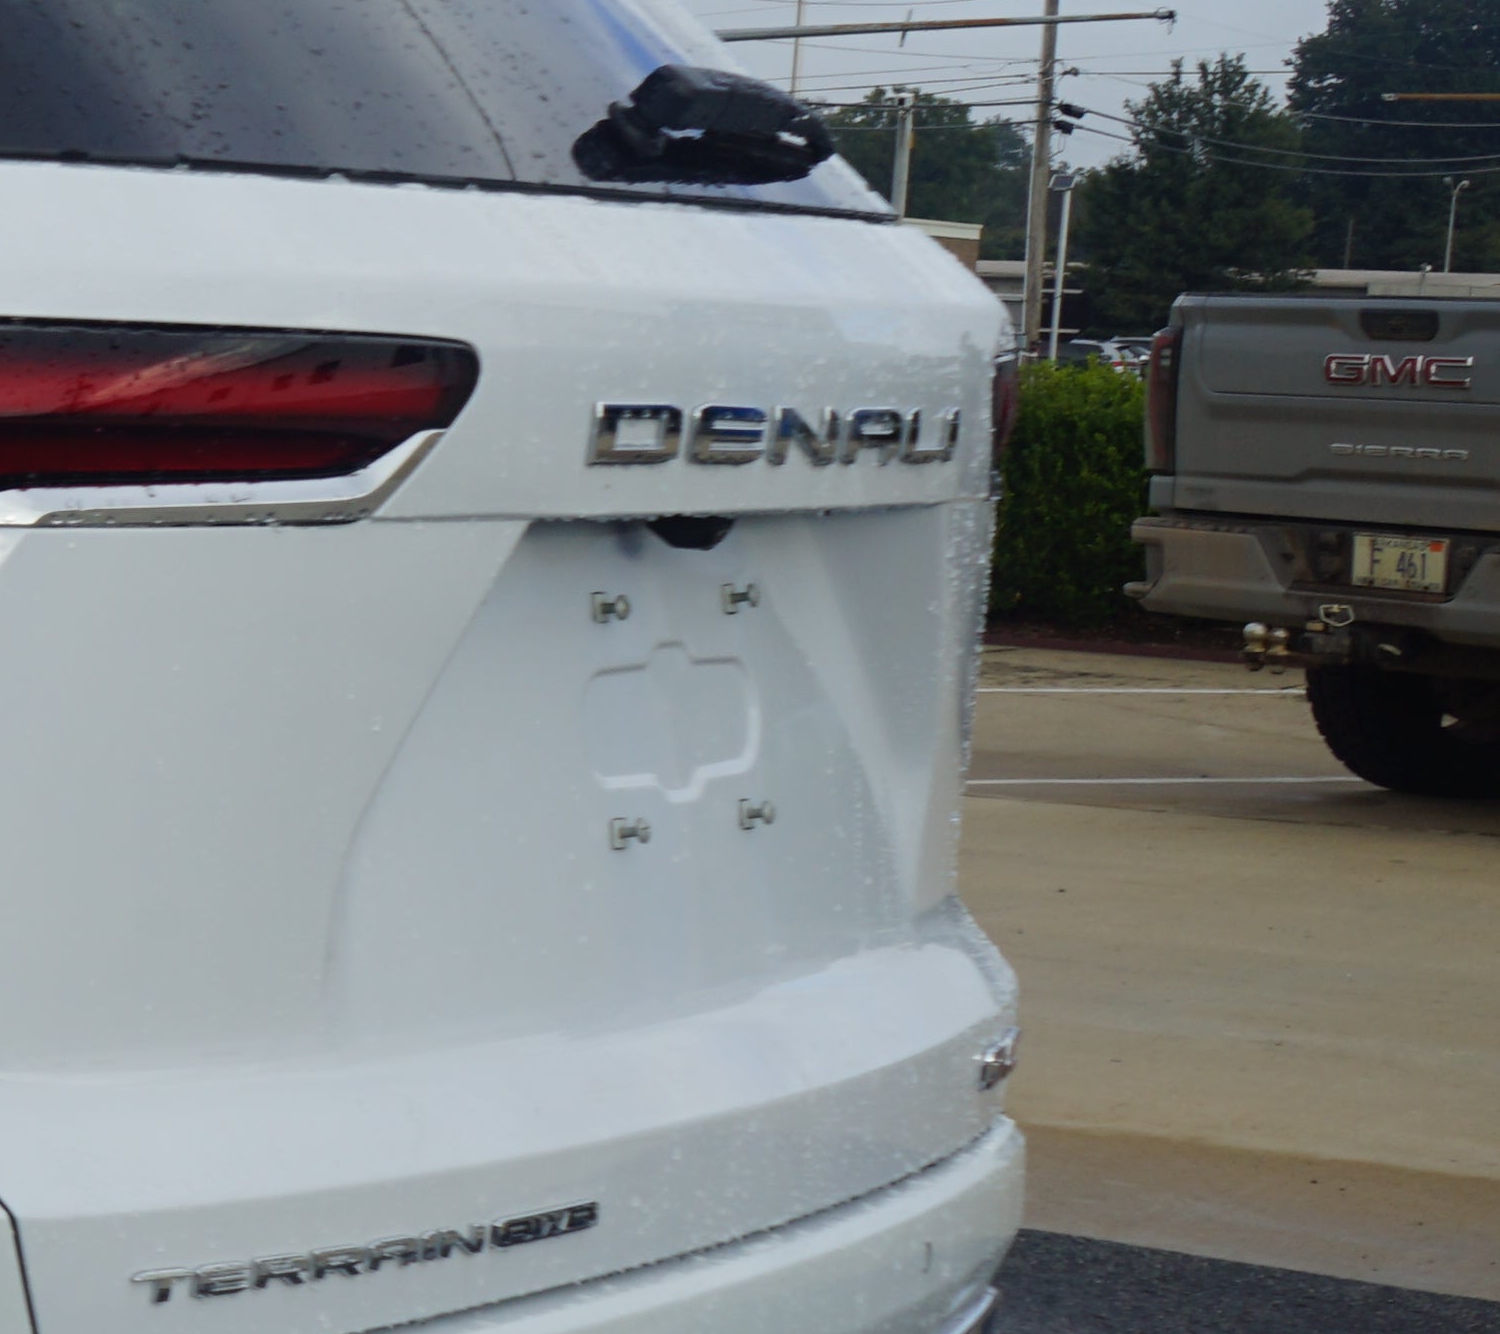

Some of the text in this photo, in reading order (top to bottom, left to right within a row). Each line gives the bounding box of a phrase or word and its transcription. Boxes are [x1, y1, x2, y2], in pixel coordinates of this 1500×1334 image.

[1324, 353, 1474, 388] GMC
[586, 402, 961, 467] DENALI
[1330, 442, 1470, 462] SIERRA
[130, 1223, 486, 1303] TERRAIN
